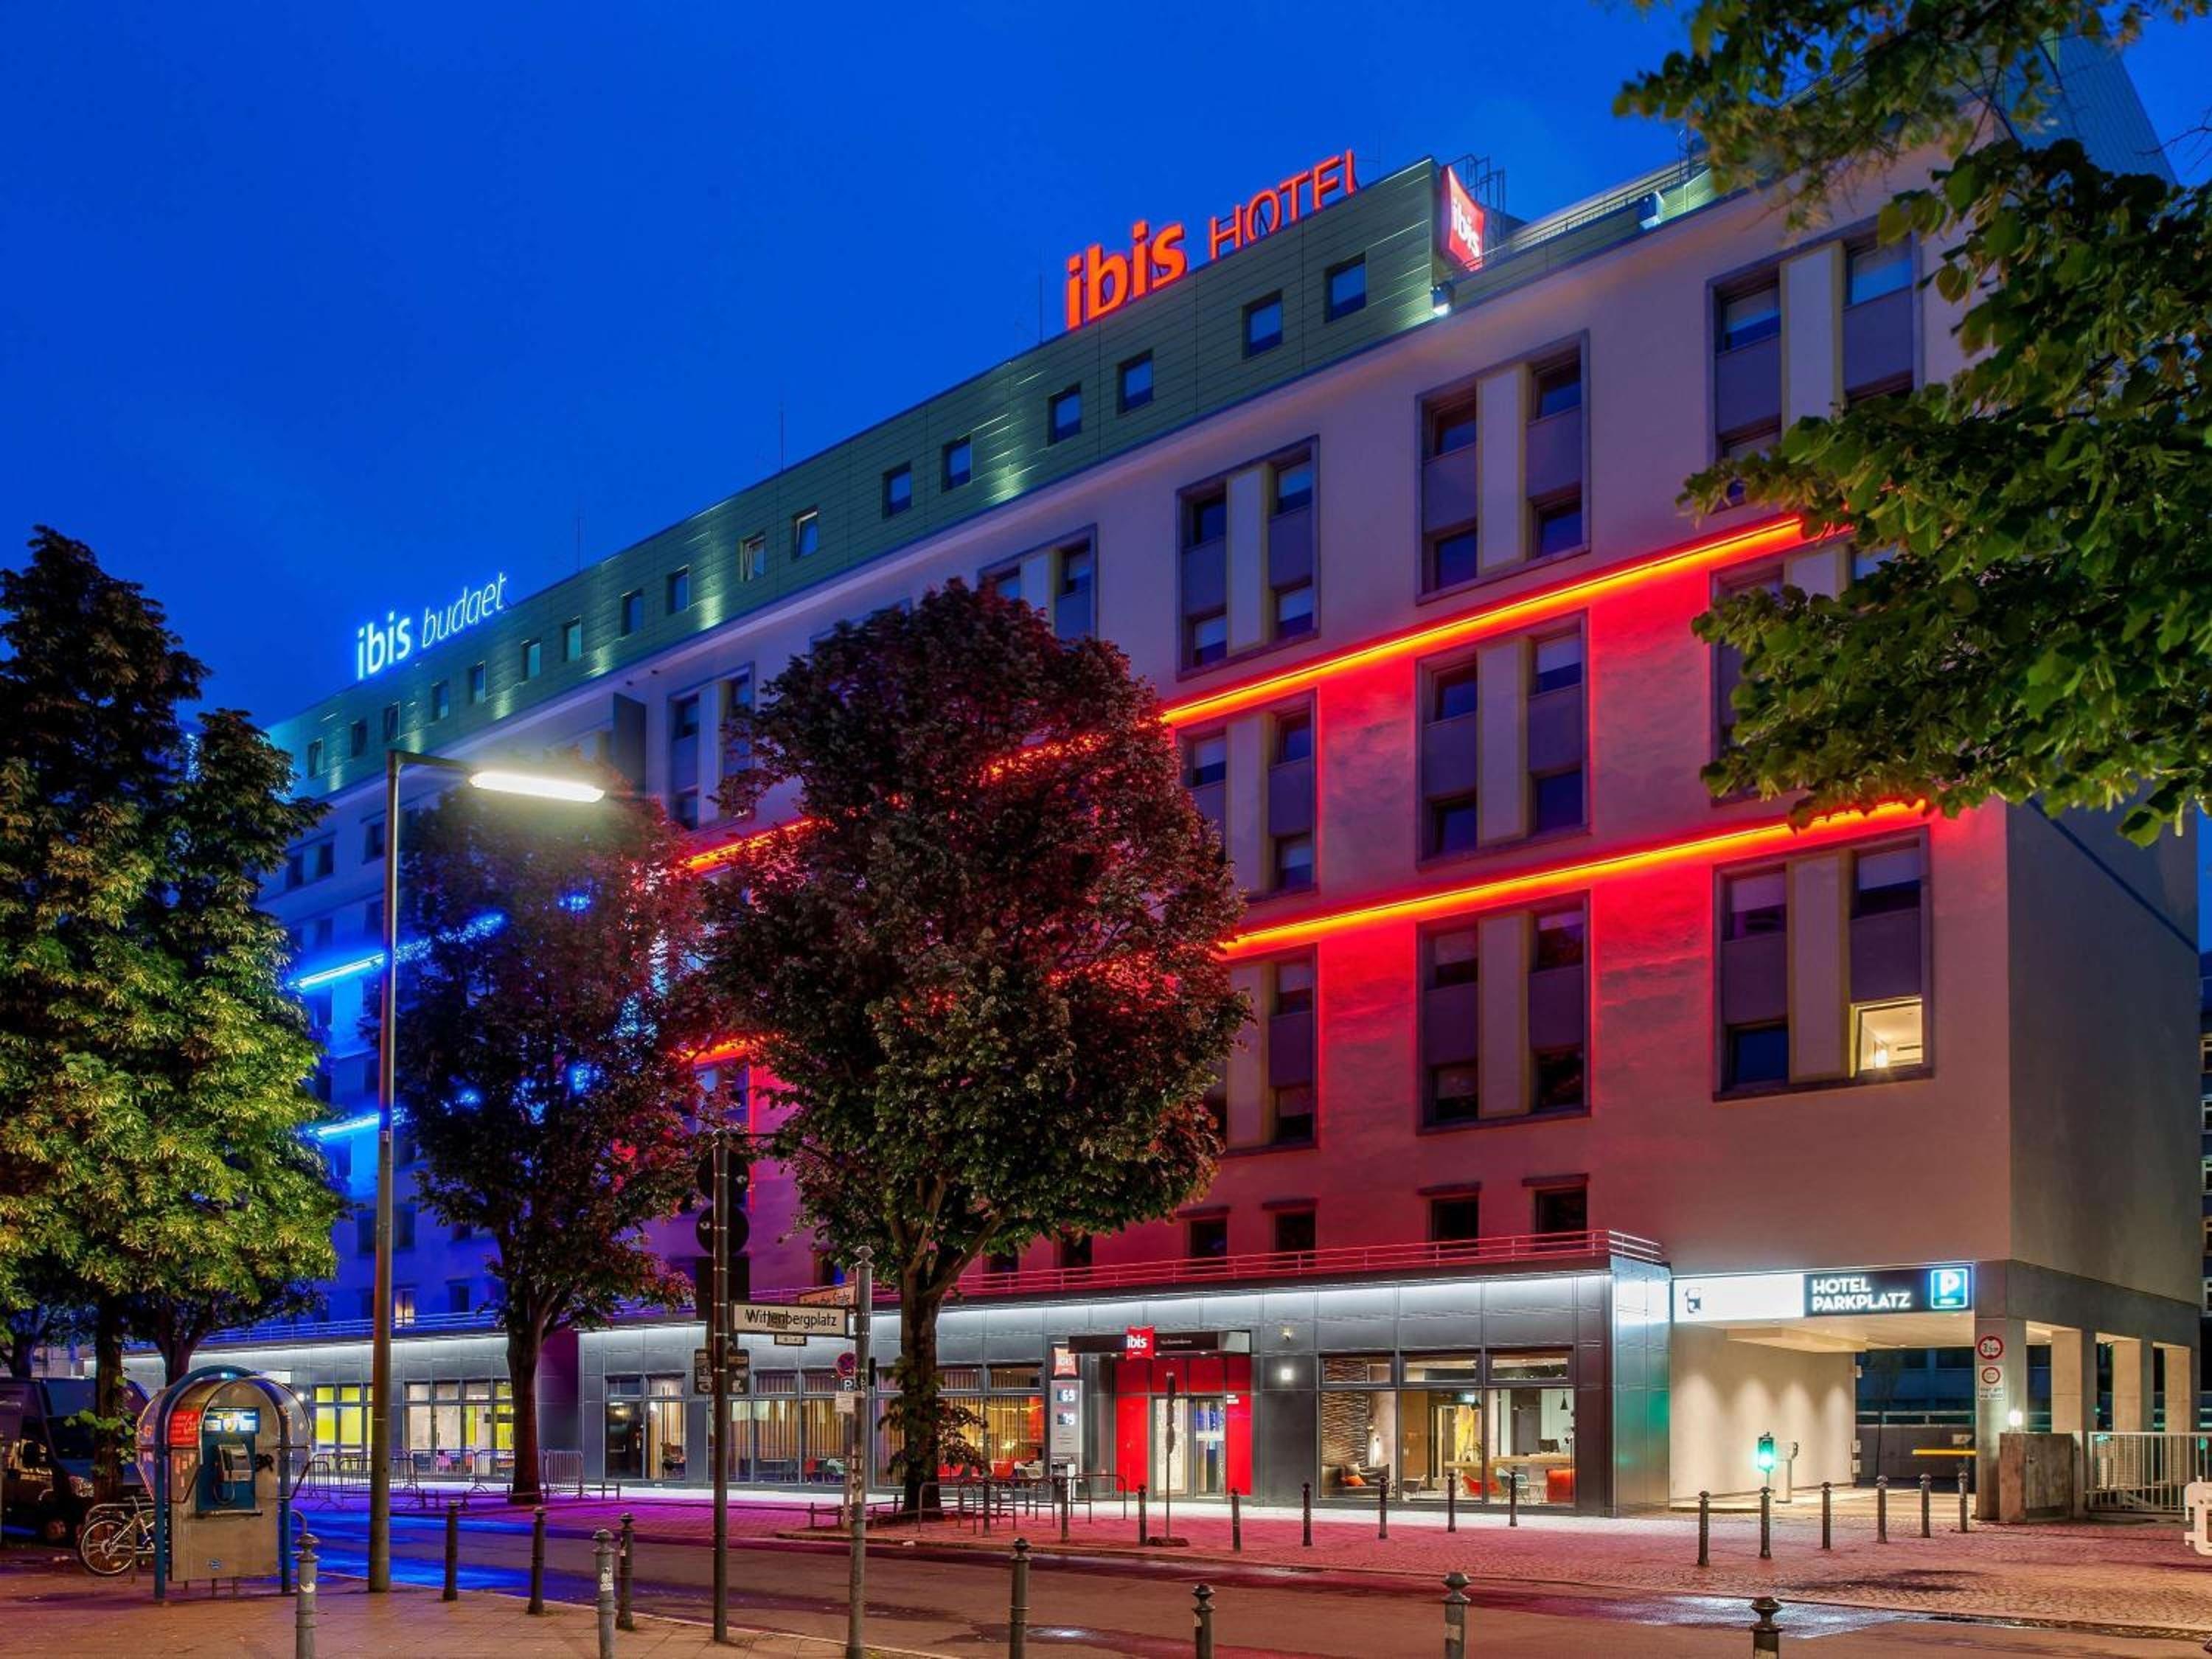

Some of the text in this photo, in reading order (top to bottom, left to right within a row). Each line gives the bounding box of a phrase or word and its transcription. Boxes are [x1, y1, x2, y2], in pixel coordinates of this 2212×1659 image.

[1451, 198, 1480, 258] ibis
[1067, 149, 1355, 331] ibis HOTEL
[358, 573, 507, 679] ibis budget
[1812, 1276, 1871, 1294] HOTEL
[1941, 1273, 1960, 1297] P
[1812, 1292, 1911, 1311] PARKPLATZ
[745, 1309, 837, 1329] Wittenbergplatz
[1127, 1335, 1147, 1349] ibis
[1062, 1389, 1076, 1402] 69
